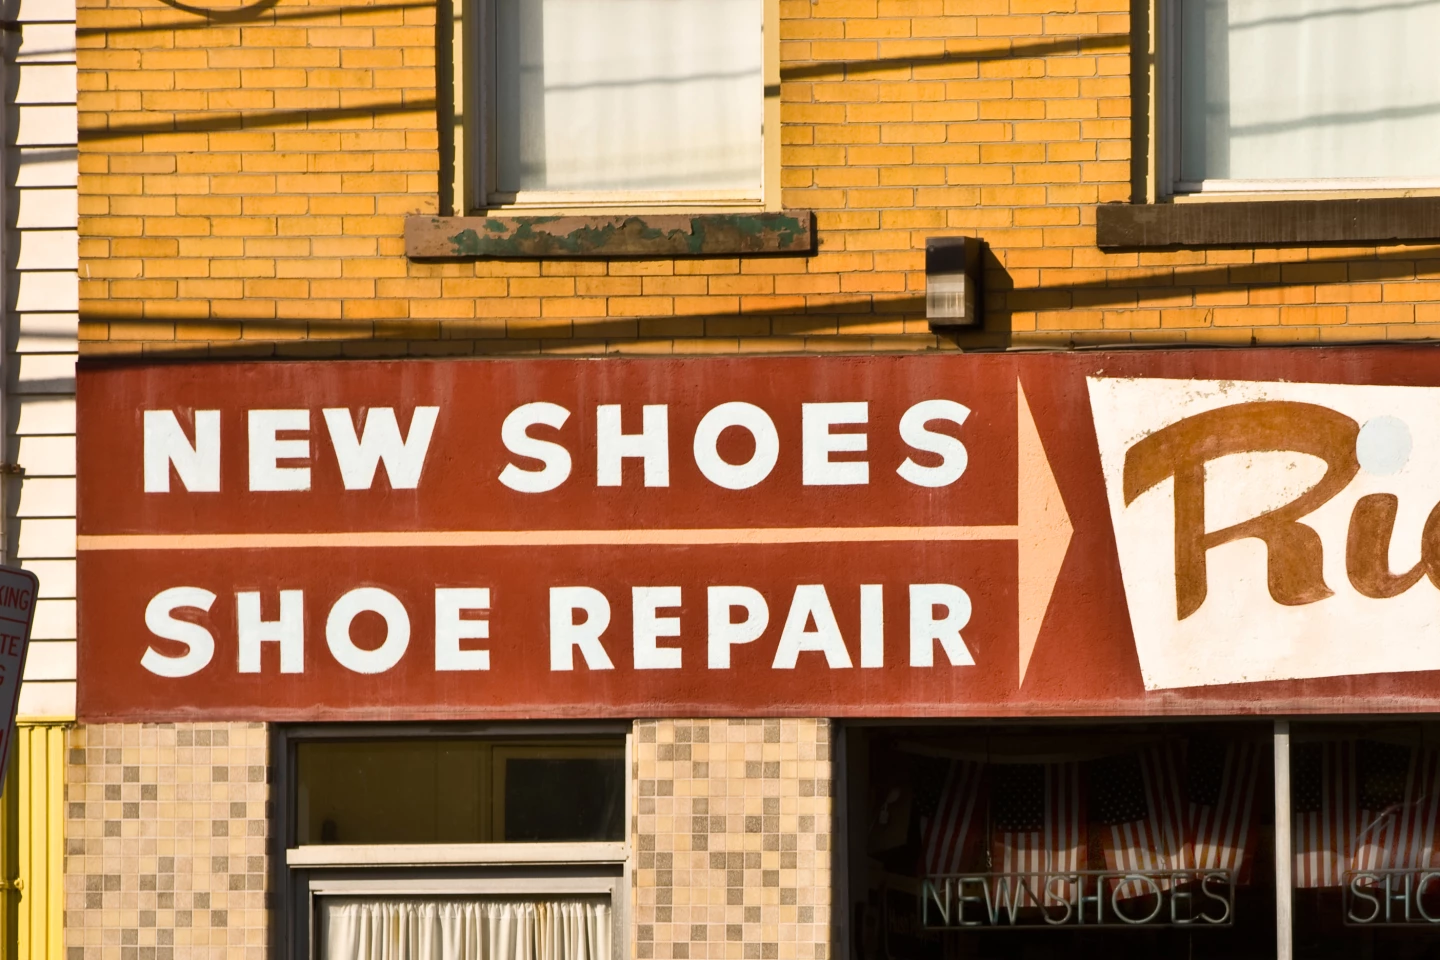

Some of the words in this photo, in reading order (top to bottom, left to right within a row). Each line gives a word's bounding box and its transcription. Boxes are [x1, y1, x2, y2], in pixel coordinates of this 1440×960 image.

[143, 406, 440, 493] NEW
[497, 400, 971, 494] SHOES
[140, 586, 491, 678] SHOE
[549, 584, 976, 671] REPAIR
[922, 875, 1025, 927] NEW
[1043, 872, 1232, 926] SHOES
